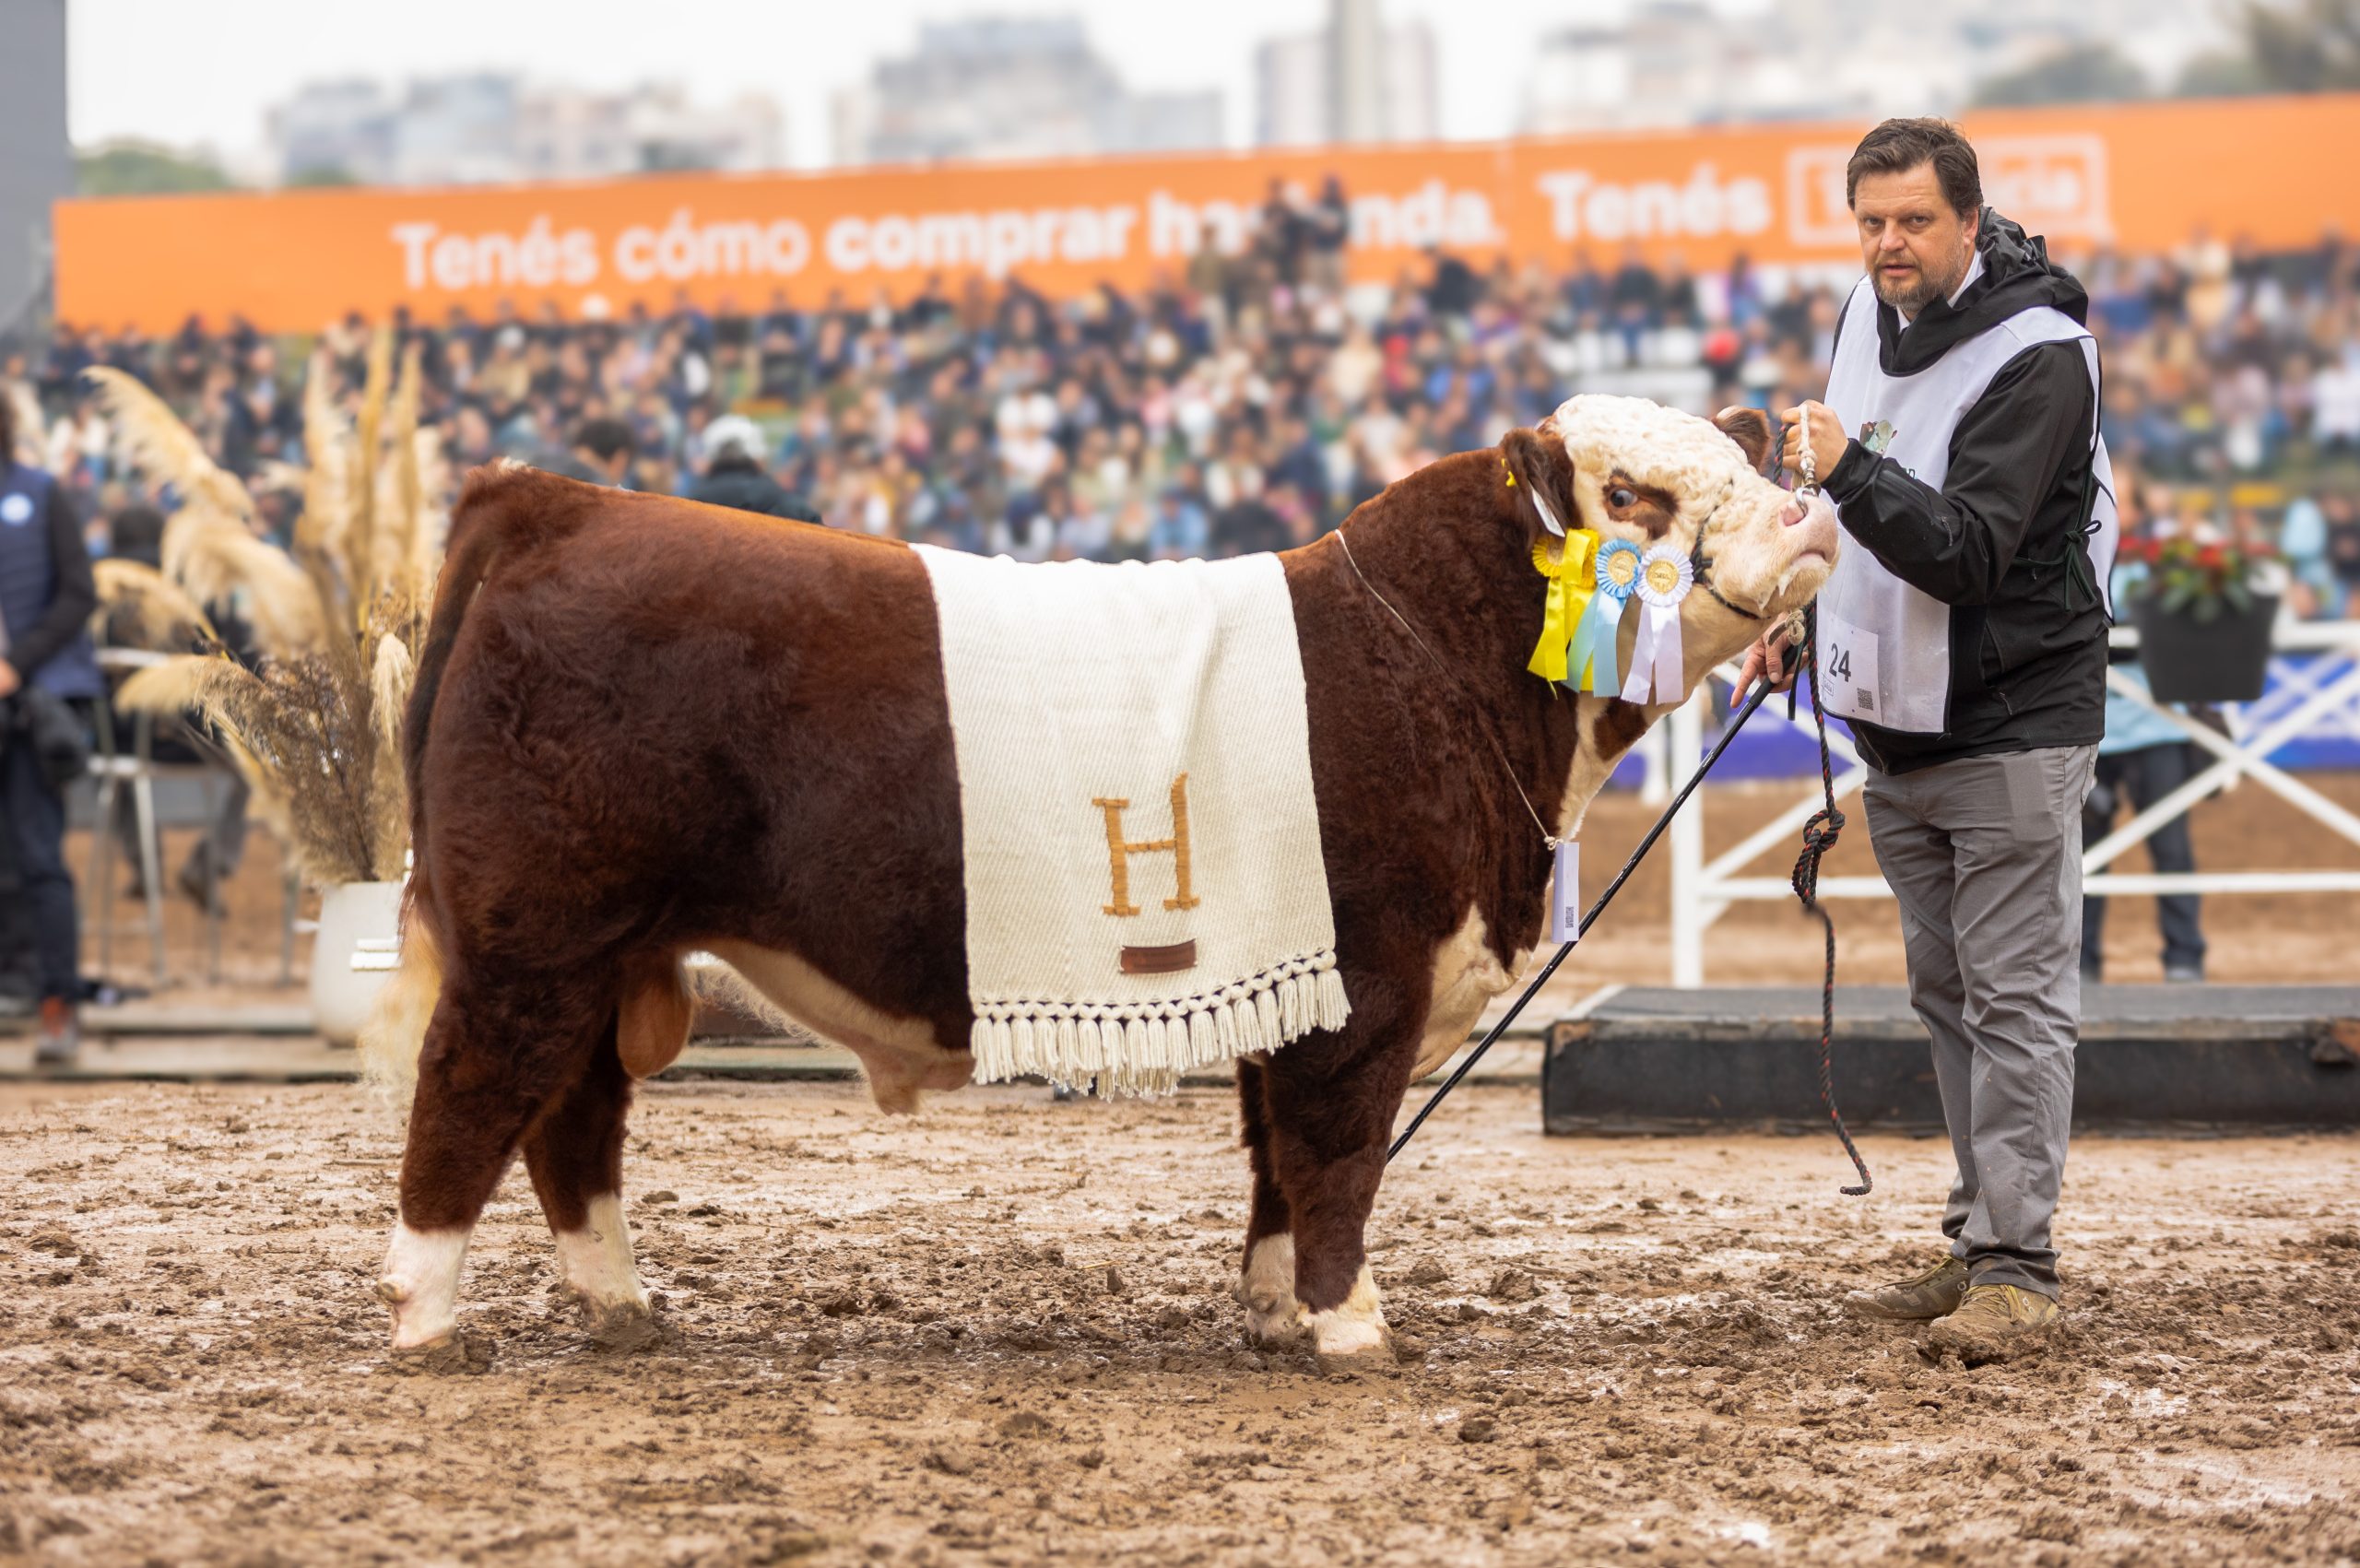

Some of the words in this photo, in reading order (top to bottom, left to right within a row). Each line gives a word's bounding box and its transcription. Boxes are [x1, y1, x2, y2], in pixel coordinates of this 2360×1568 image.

[1537, 163, 1774, 242] Tenés
[392, 214, 599, 289] Tenés
[615, 207, 810, 281] cómo
[826, 206, 1138, 280] comprar
[1829, 643, 1851, 683] 24
[1092, 771, 1200, 916] H
